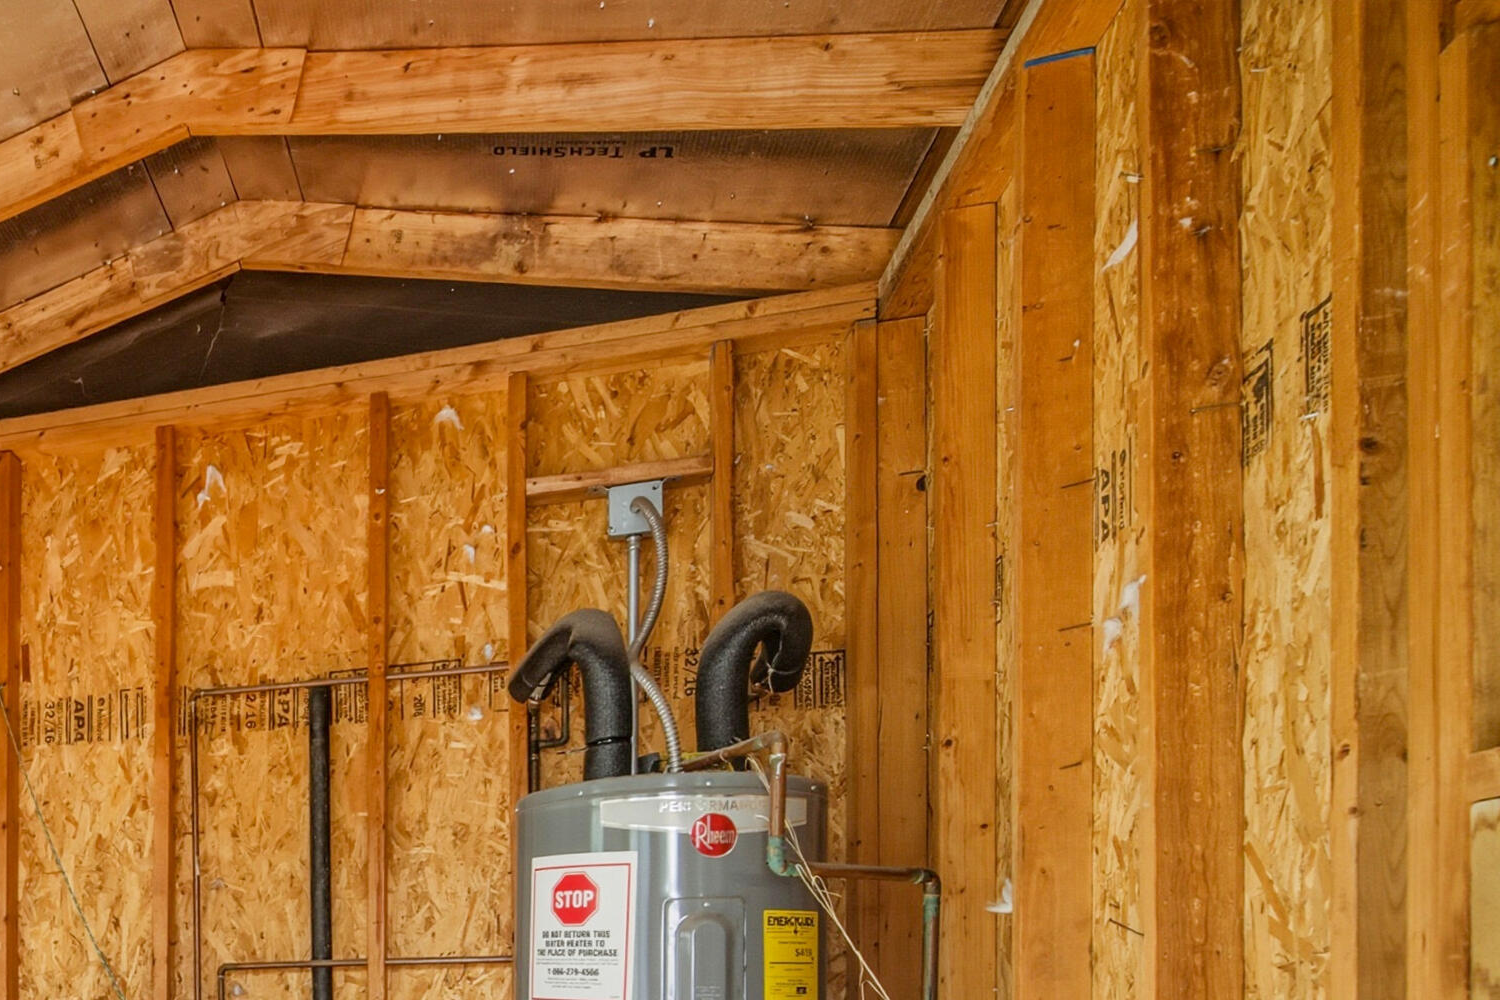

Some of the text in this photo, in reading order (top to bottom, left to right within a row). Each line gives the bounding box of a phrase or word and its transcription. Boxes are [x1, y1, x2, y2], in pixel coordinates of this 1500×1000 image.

[639, 146, 674, 158] LP
[1101, 469, 1110, 543] APA
[683, 648, 699, 696] 32/16
[44, 701, 55, 744] 32/16
[74, 700, 85, 742] APA
[245, 693, 256, 729] 2/16
[695, 814, 735, 850] Rheem
[555, 890, 594, 909] STOP
[593, 930, 611, 938] THIS
